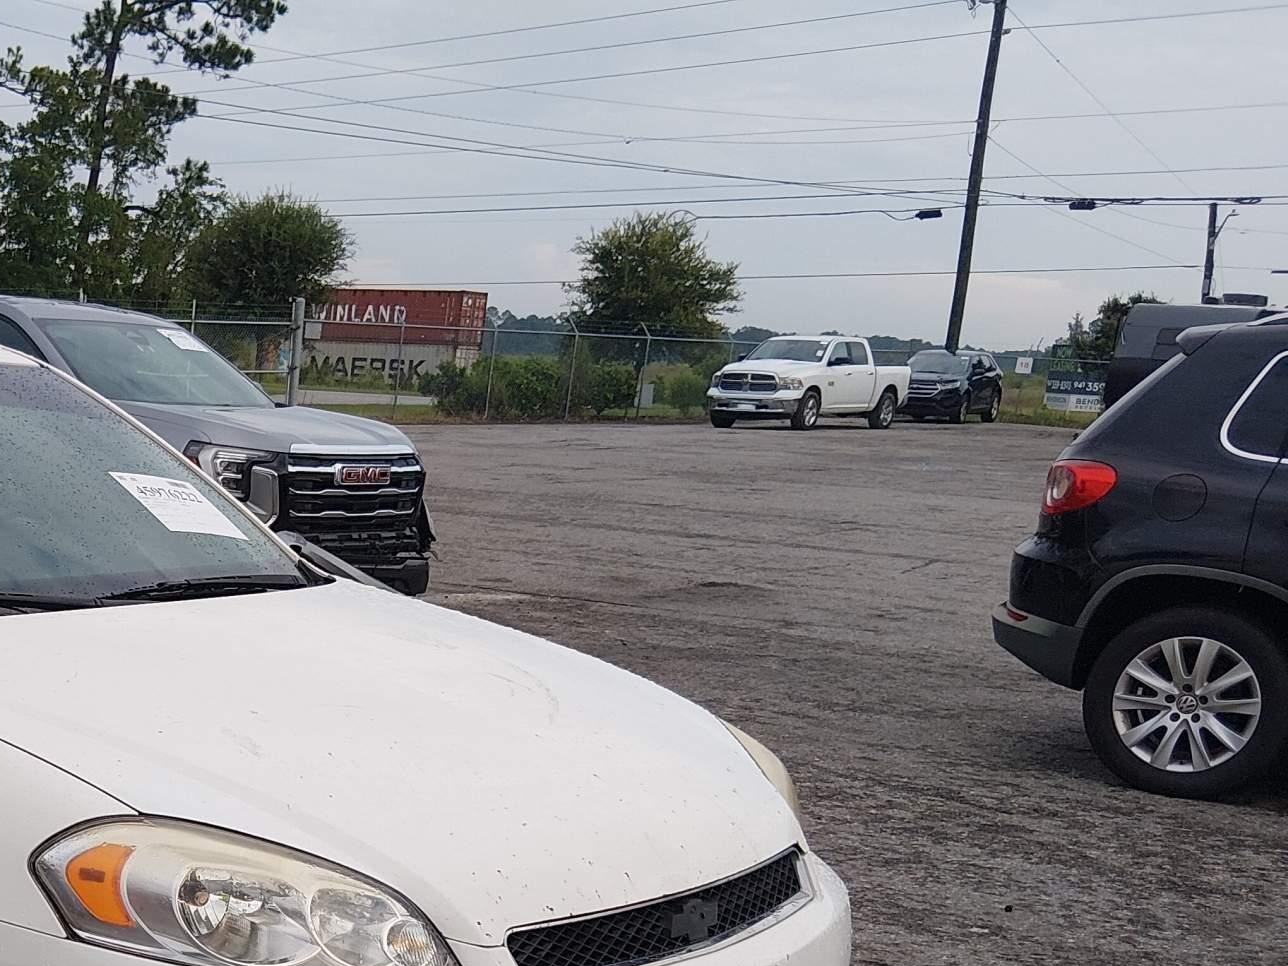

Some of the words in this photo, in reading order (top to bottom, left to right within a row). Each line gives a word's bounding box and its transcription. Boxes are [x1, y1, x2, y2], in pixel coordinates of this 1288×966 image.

[312, 303, 407, 323] WINLAND
[310, 355, 426, 382] MAERSK
[343, 467, 390, 482] GMC
[136, 485, 203, 504] 45976222
